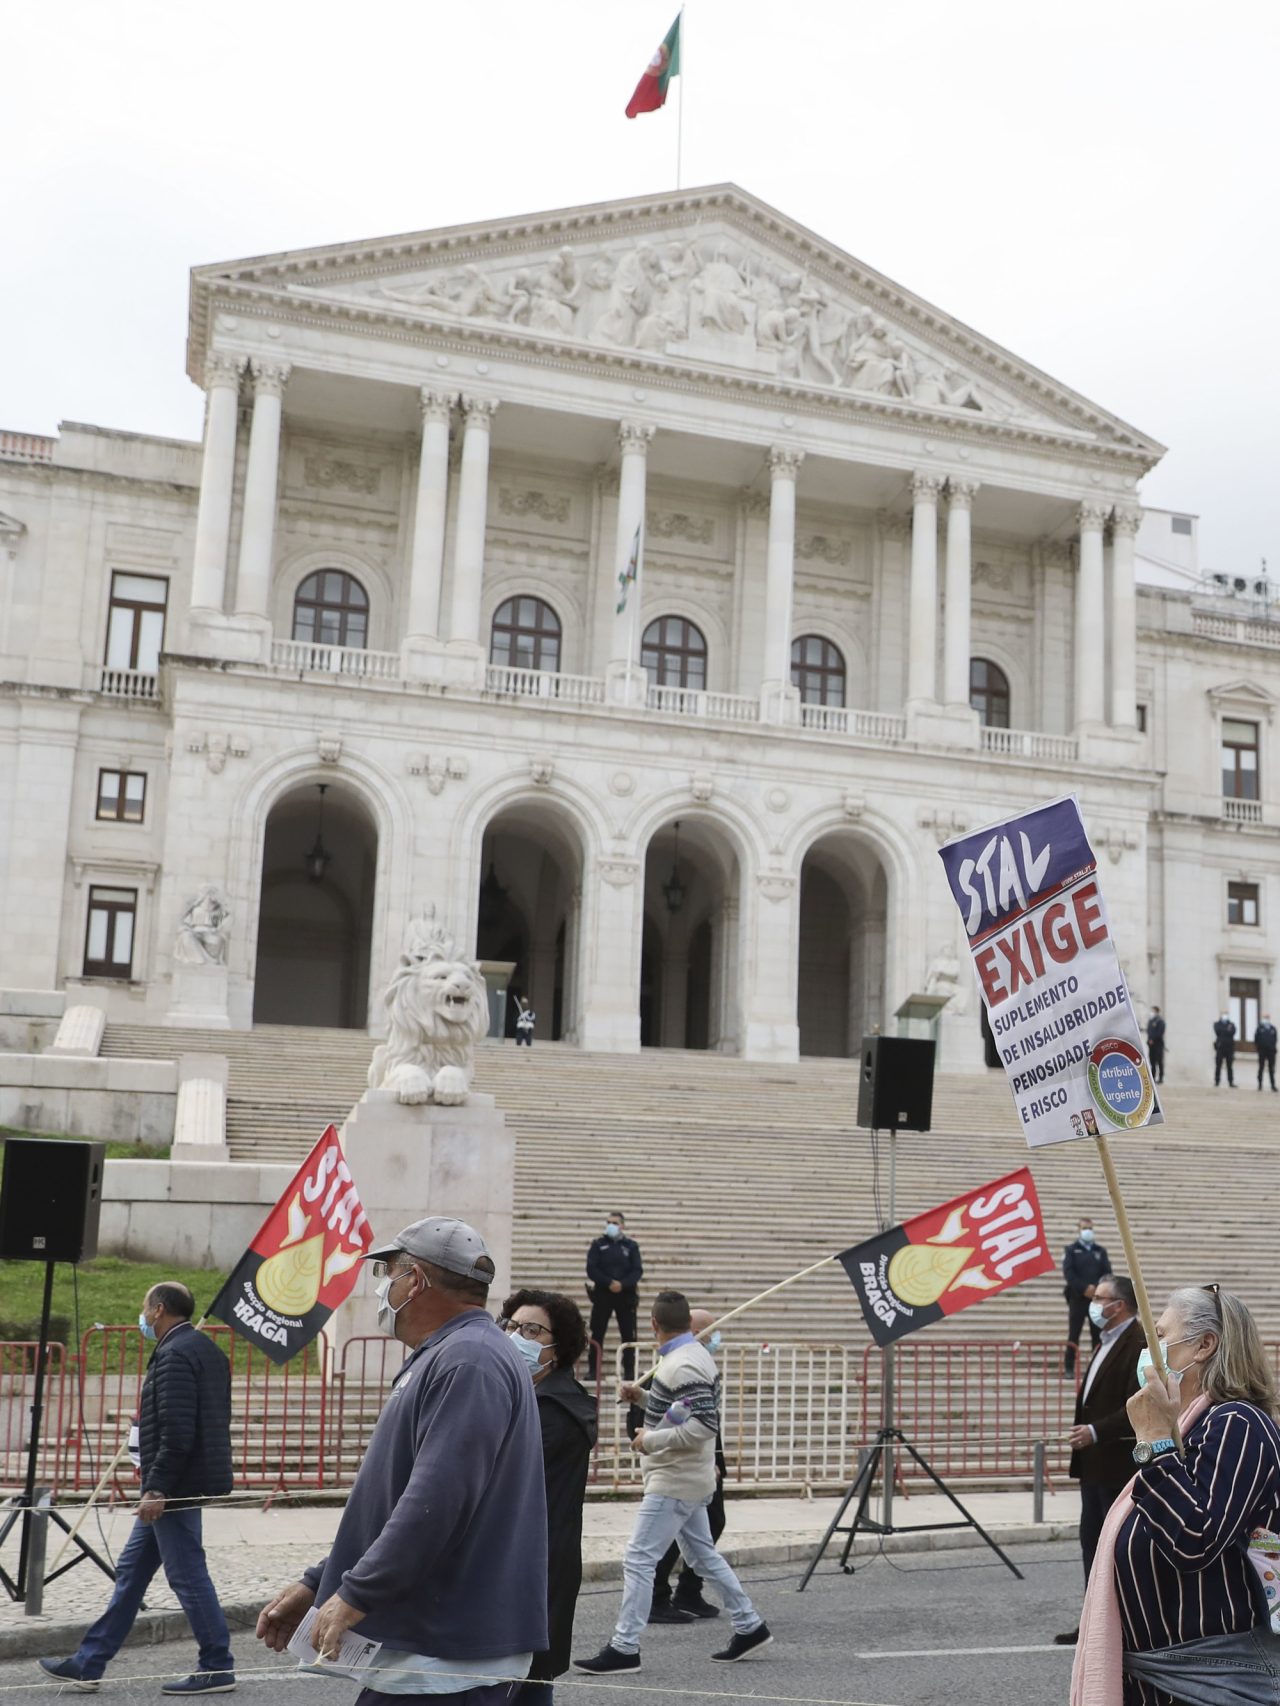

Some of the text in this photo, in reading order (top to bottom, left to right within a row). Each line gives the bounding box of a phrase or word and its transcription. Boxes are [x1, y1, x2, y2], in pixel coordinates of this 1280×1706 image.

[958, 831, 1051, 936] STAL
[974, 882, 1109, 1009] EXIGE
[994, 975, 1079, 1036] SUPLEMENTO
[1003, 984, 1127, 1065] DE INSALUBRIDADE
[1013, 1040, 1093, 1094] PENOSIDADE
[1101, 1042, 1119, 1053] RISCO
[1102, 1066, 1134, 1079] atribuir
[1021, 1106, 1030, 1124] E
[1030, 1087, 1068, 1119] RISCO
[1106, 1089, 1140, 1103] urgente
[304, 1145, 366, 1247] STAL
[968, 1183, 1042, 1280] STAL
[243, 1281, 304, 1328] Direcção Regional
[859, 1262, 897, 1329] BRAGA
